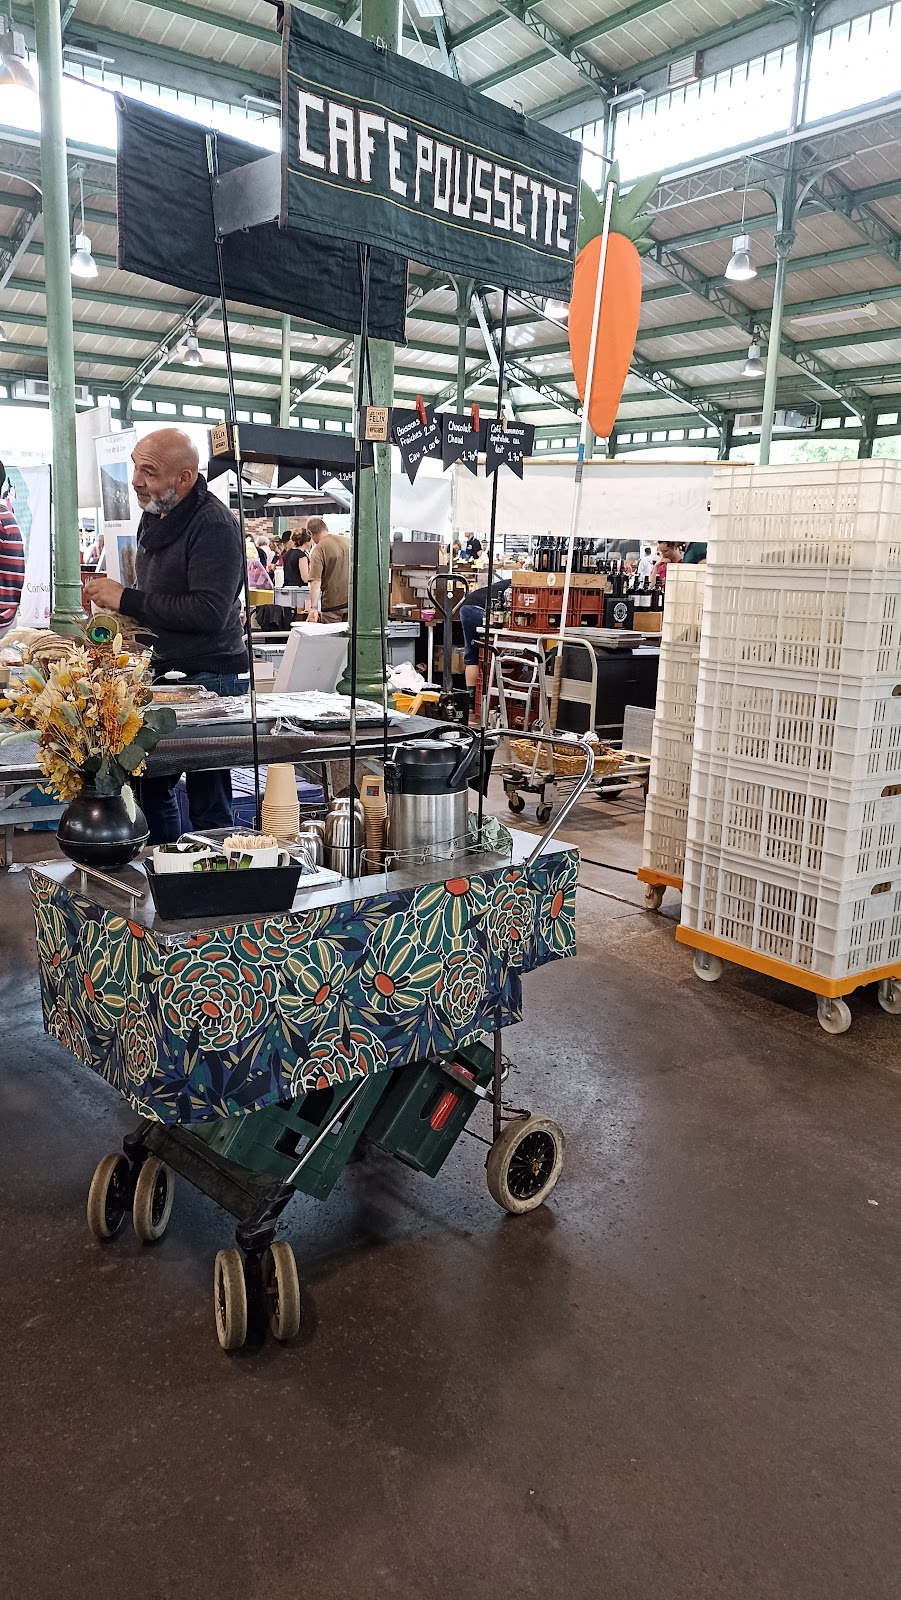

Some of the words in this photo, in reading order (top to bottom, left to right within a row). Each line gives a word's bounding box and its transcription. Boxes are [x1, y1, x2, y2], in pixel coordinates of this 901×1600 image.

[297, 86, 408, 197] CAFE
[414, 132, 572, 251] POUSSETTE
[448, 420, 472, 433] Chocolat
[447, 434, 464, 444] Chaud
